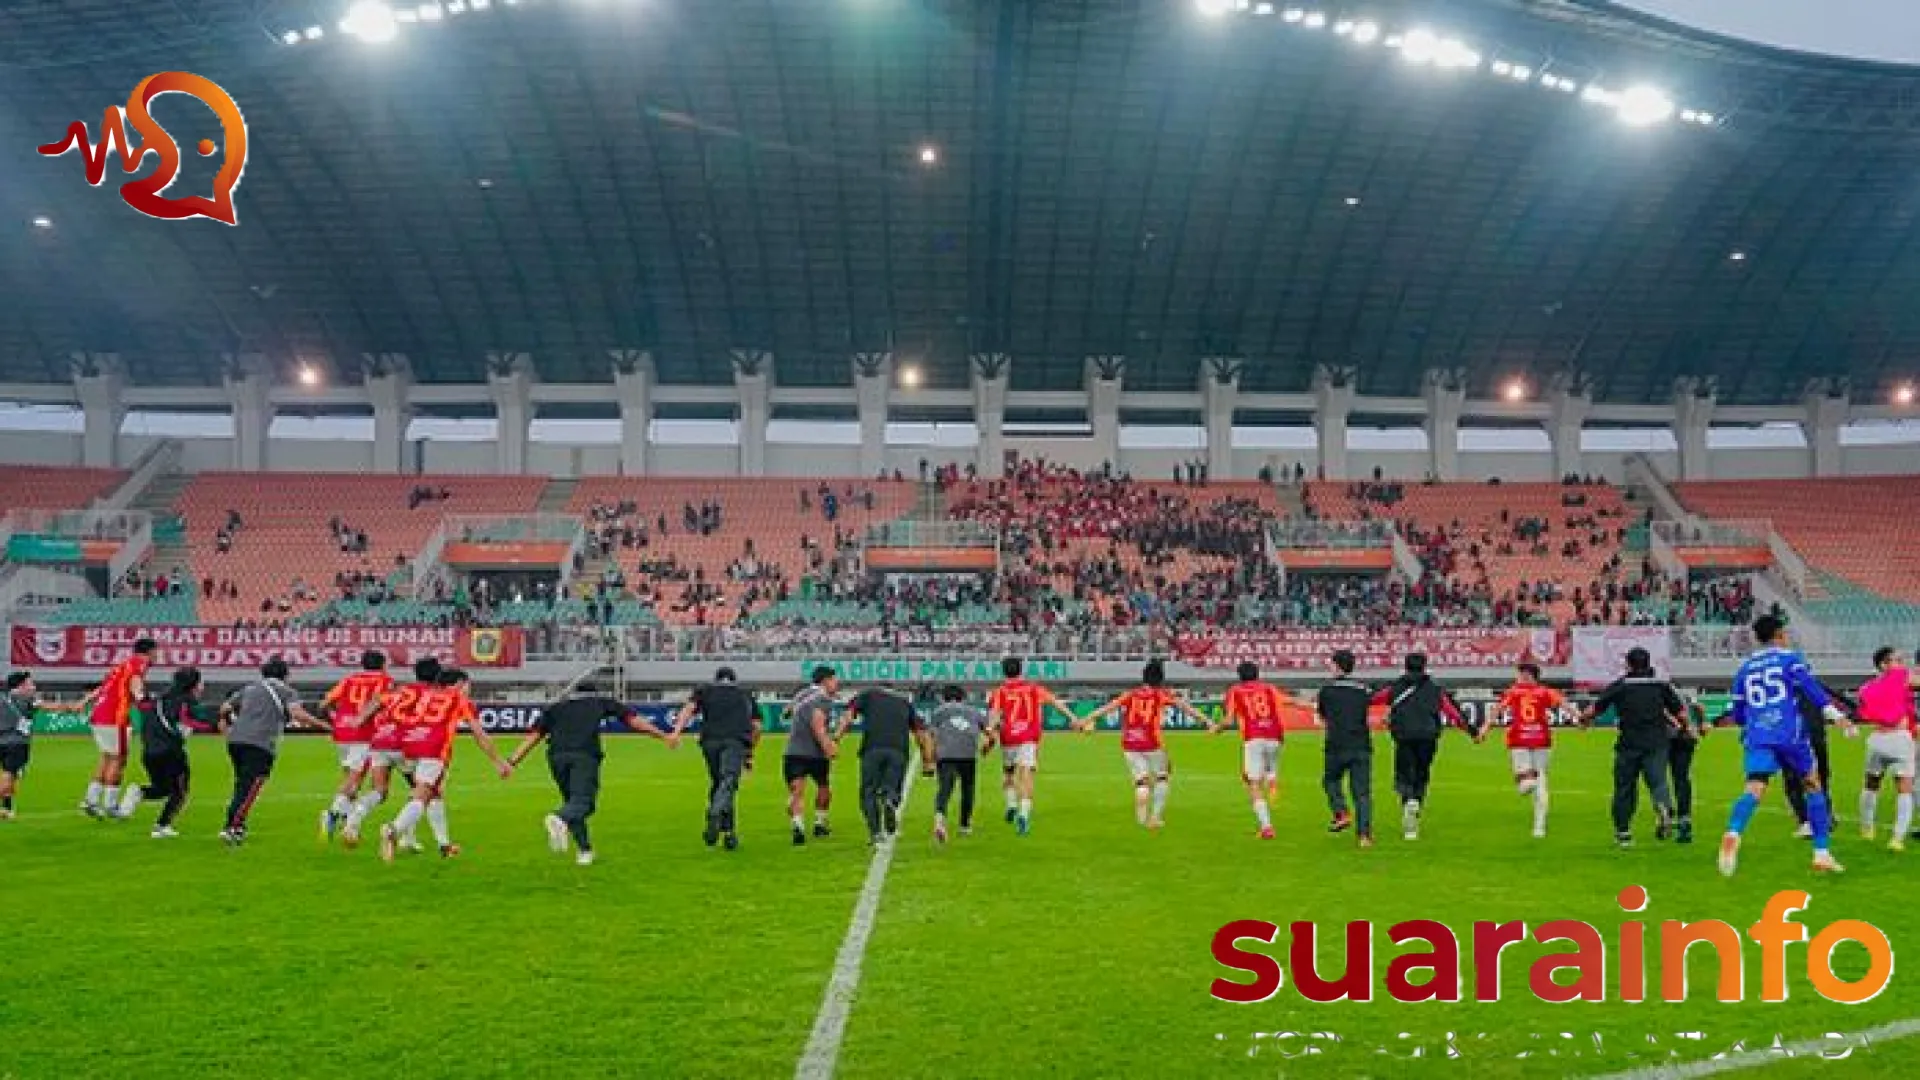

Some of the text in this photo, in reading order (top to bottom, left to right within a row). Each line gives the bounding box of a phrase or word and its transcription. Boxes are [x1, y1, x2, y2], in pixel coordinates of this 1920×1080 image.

[84, 627, 207, 644] SELAMAT
[801, 660, 912, 682] SADION
[1745, 666, 1786, 708] 65
